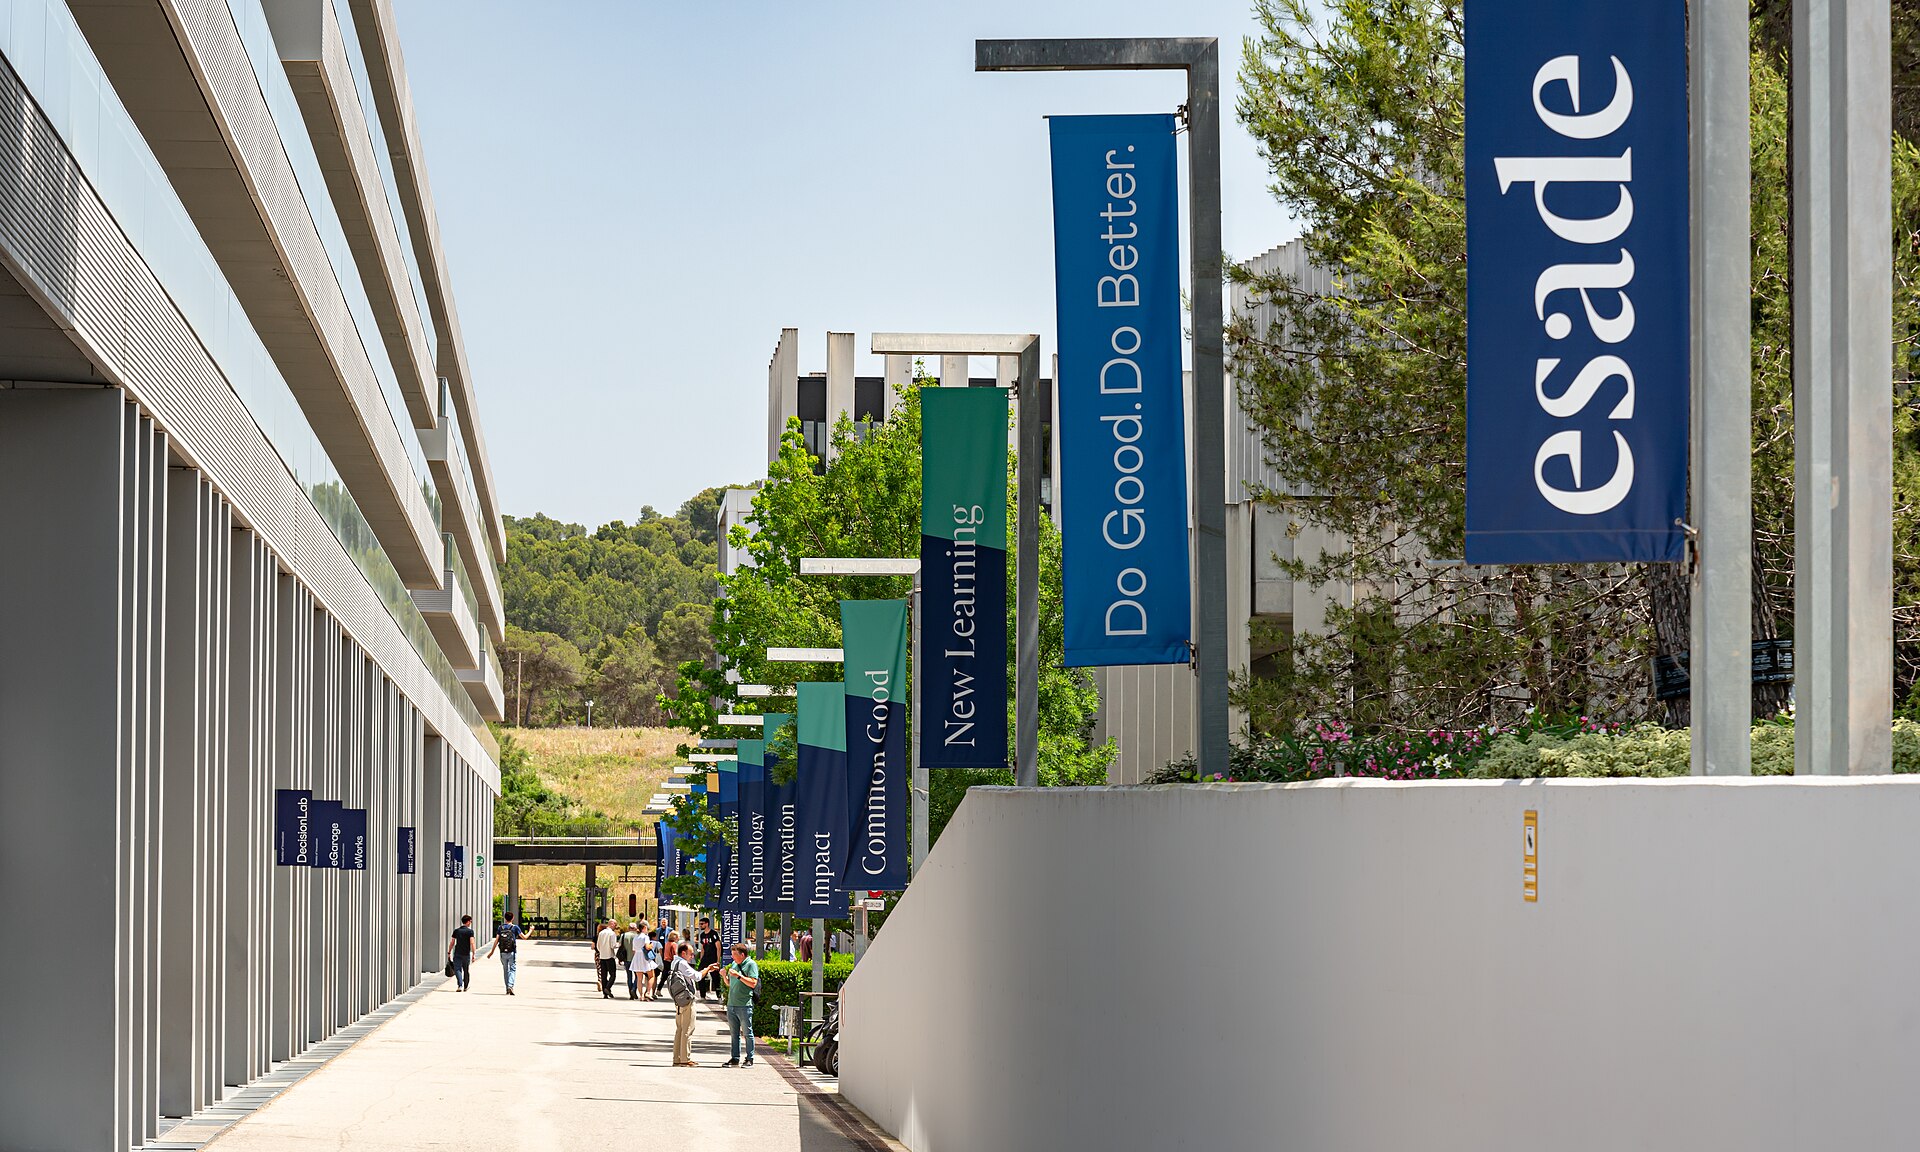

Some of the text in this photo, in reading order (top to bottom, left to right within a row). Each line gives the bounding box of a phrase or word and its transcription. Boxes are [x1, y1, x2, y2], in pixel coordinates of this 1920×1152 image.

[1494, 55, 1635, 515] esade
[1097, 145, 1147, 636] Do Good. Do Better.
[944, 504, 985, 747] New Learning
[865, 669, 890, 744] Good
[296, 797, 308, 864] DecisionLab
[329, 822, 341, 867] eGarage
[354, 835, 364, 869] eWorks
[748, 811, 764, 903] Technology
[777, 804, 795, 902] Innovation
[861, 751, 887, 876] Common
[809, 831, 835, 906] Impact
